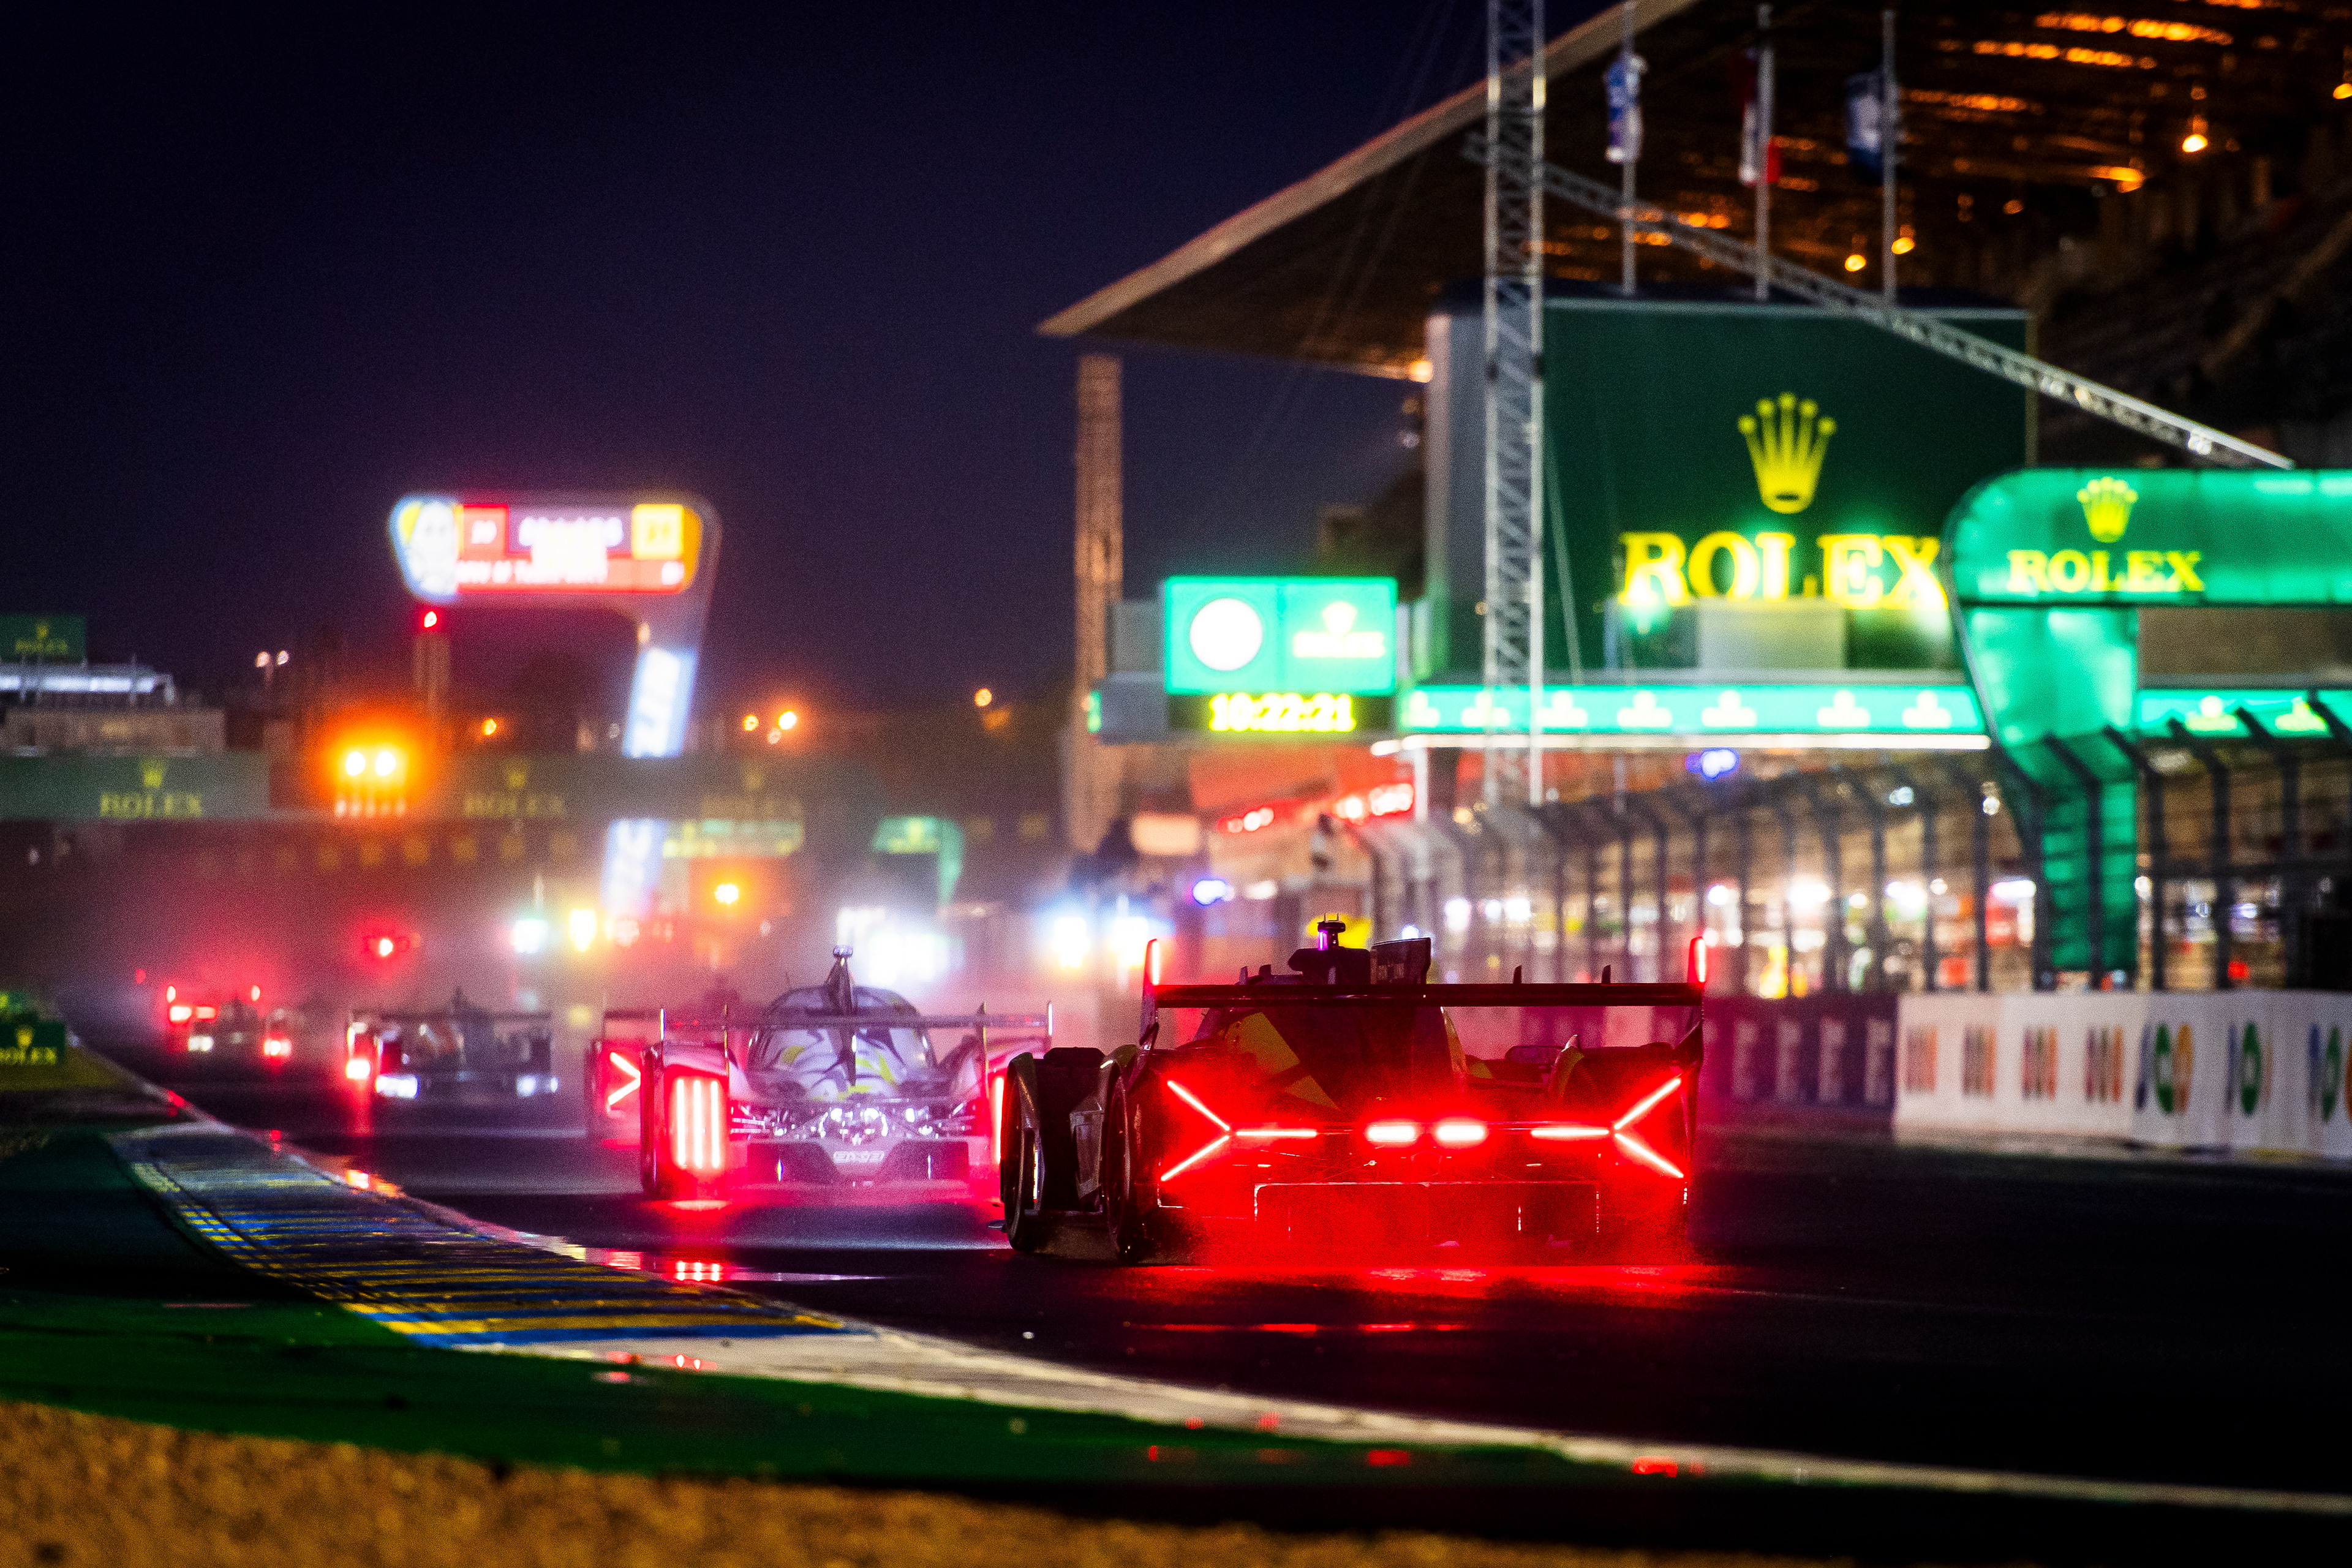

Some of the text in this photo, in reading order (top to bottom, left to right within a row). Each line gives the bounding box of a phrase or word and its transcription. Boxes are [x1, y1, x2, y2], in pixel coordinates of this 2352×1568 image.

[1619, 531, 1948, 609] ROLEX
[2007, 549, 2205, 592] ROLEX
[1208, 693, 1356, 731] 10:22:21
